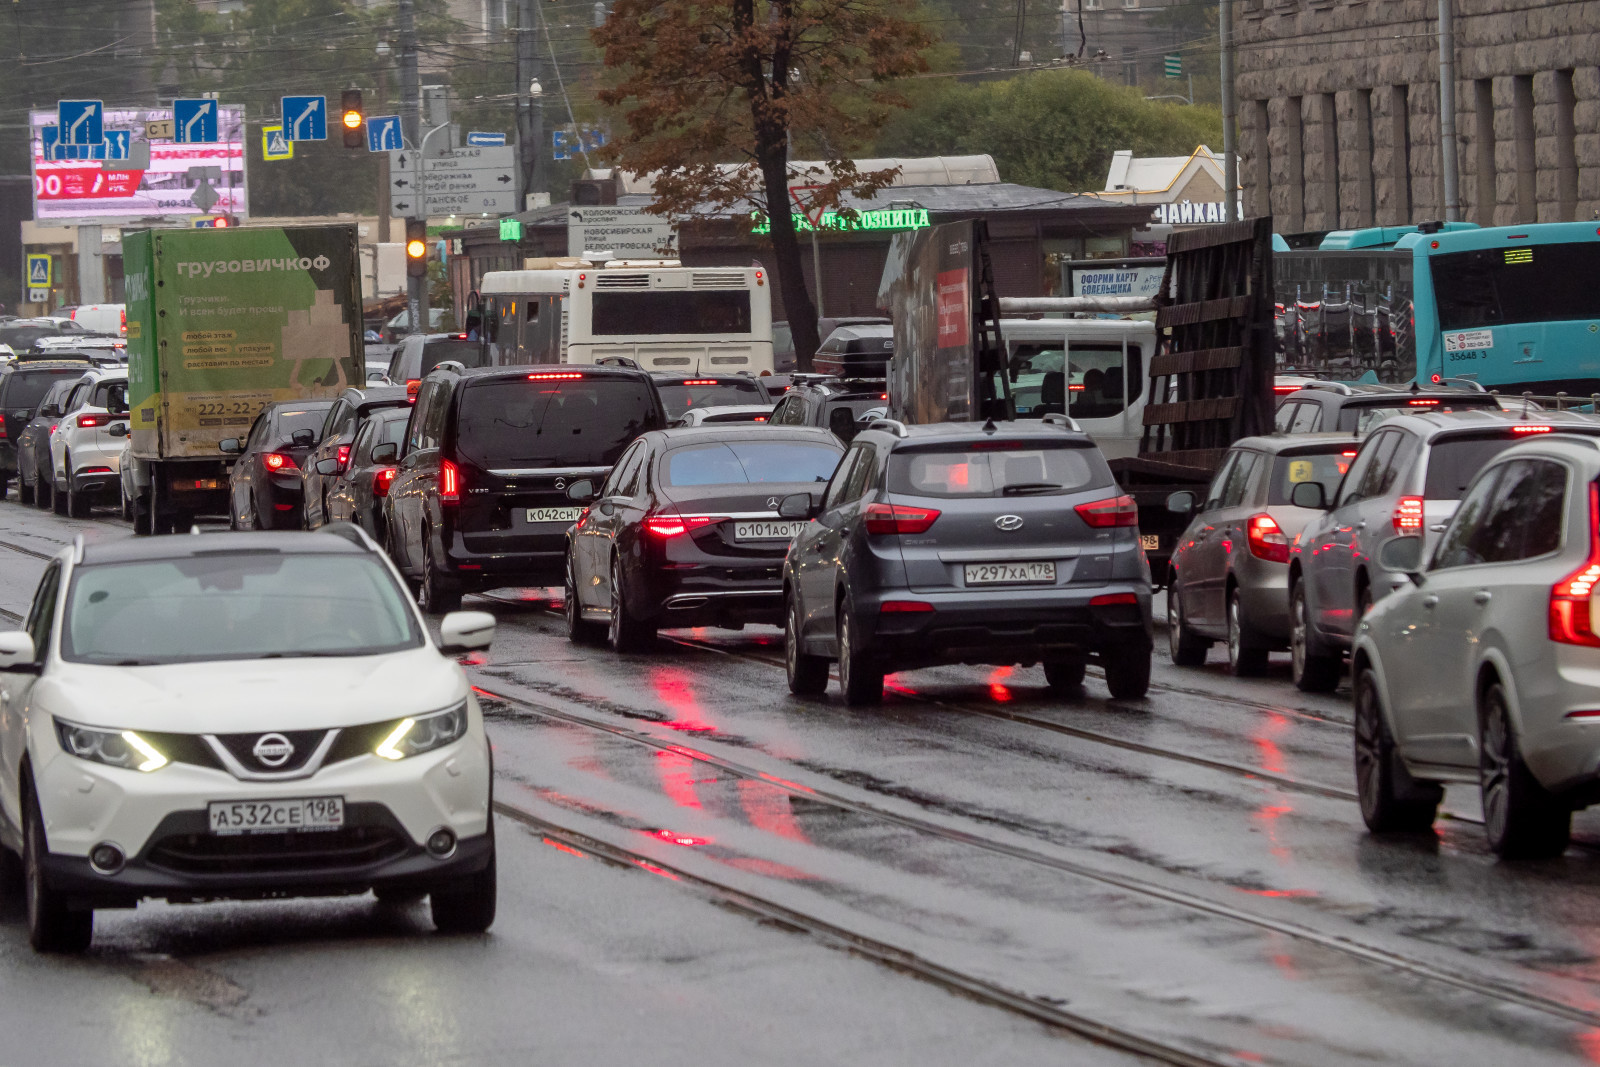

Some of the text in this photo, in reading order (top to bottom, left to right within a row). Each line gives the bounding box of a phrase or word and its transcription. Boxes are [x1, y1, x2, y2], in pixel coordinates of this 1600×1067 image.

[432, 160, 458, 170] улица
[426, 194, 469, 205] ЛАНСКОЕ
[433, 204, 462, 214] шоссе
[582, 208, 644, 217] КОЛОМЯЖСКИ
[583, 216, 617, 224] проспект
[584, 227, 653, 235] НОВОСИБИРСКАЯ
[177, 254, 331, 279] грузовичкоф
[1081, 271, 1139, 284] ОФОРМИ КАРТУ
[1081, 283, 1132, 295] БОЛЕЛЬЩИКА
[179, 305, 284, 317] И всем будет проще
[185, 331, 233, 340] любой этаж
[186, 345, 213, 354] любой
[1449, 350, 1488, 362] 35648 3
[186, 360, 229, 369] расставим
[241, 358, 270, 366] местам
[199, 401, 273, 416] 222-22-2
[530, 508, 574, 521] К042СН
[739, 523, 789, 537] О101АО
[970, 563, 1051, 581] У297ХА 178
[216, 800, 337, 827] А532СЕ 198
